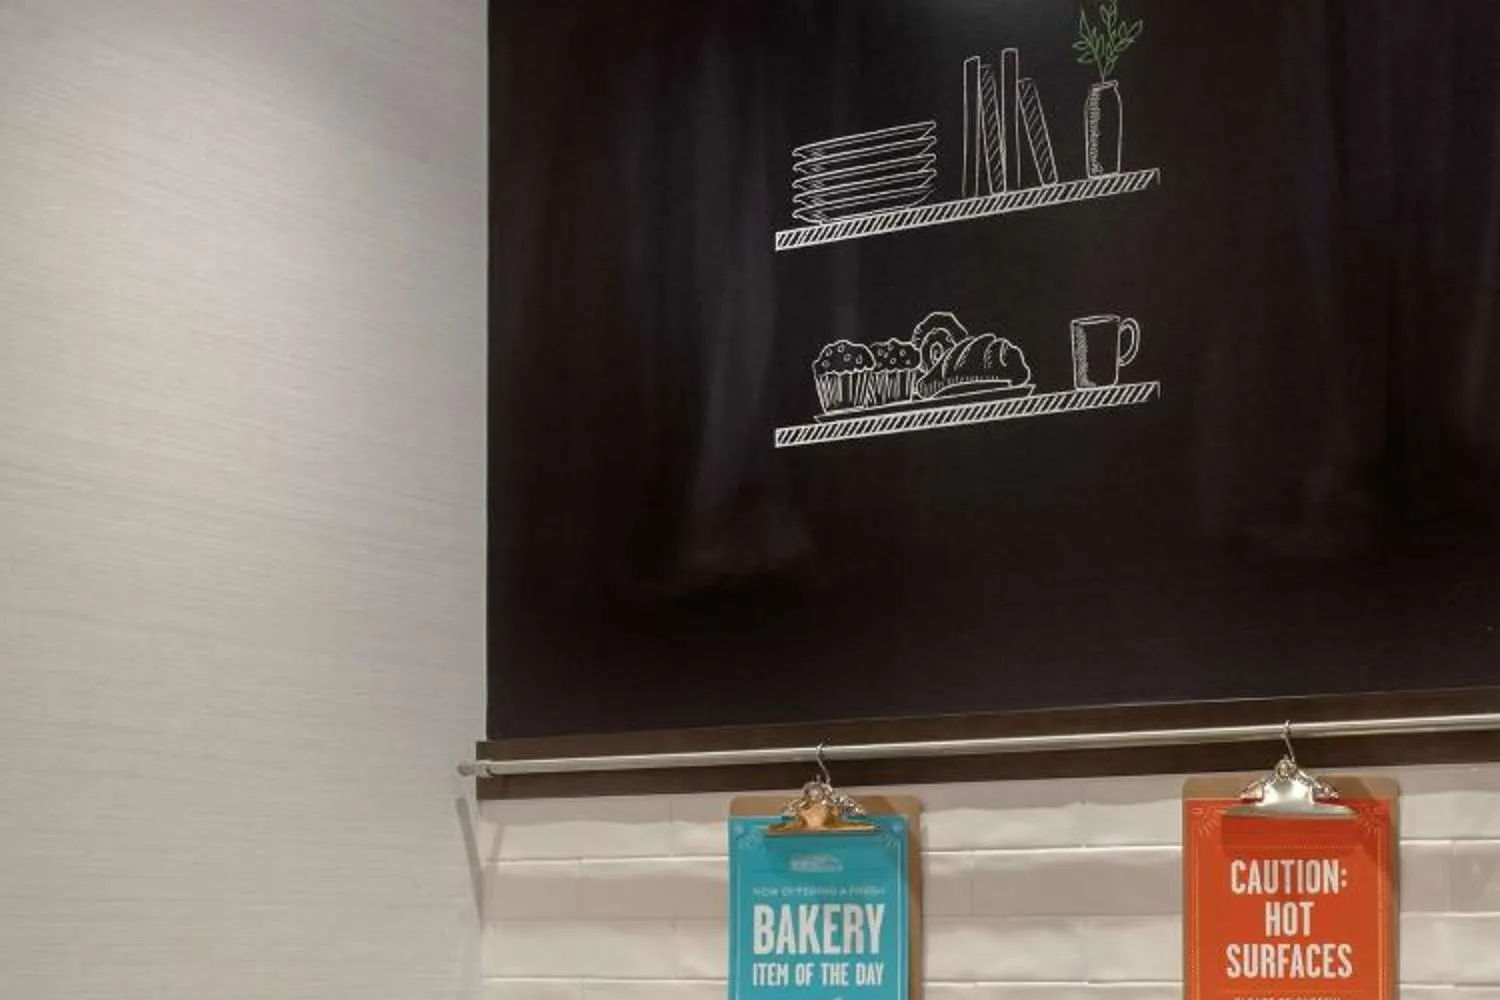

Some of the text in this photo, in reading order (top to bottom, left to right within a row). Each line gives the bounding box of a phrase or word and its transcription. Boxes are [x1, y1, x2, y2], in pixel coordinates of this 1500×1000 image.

[1230, 858, 1348, 895] CAUTION:
[753, 902, 886, 956] BAKERY
[1264, 901, 1315, 937] HOT
[753, 962, 886, 987] ITEM OF THE DAY
[1225, 943, 1354, 979] SURFACES
